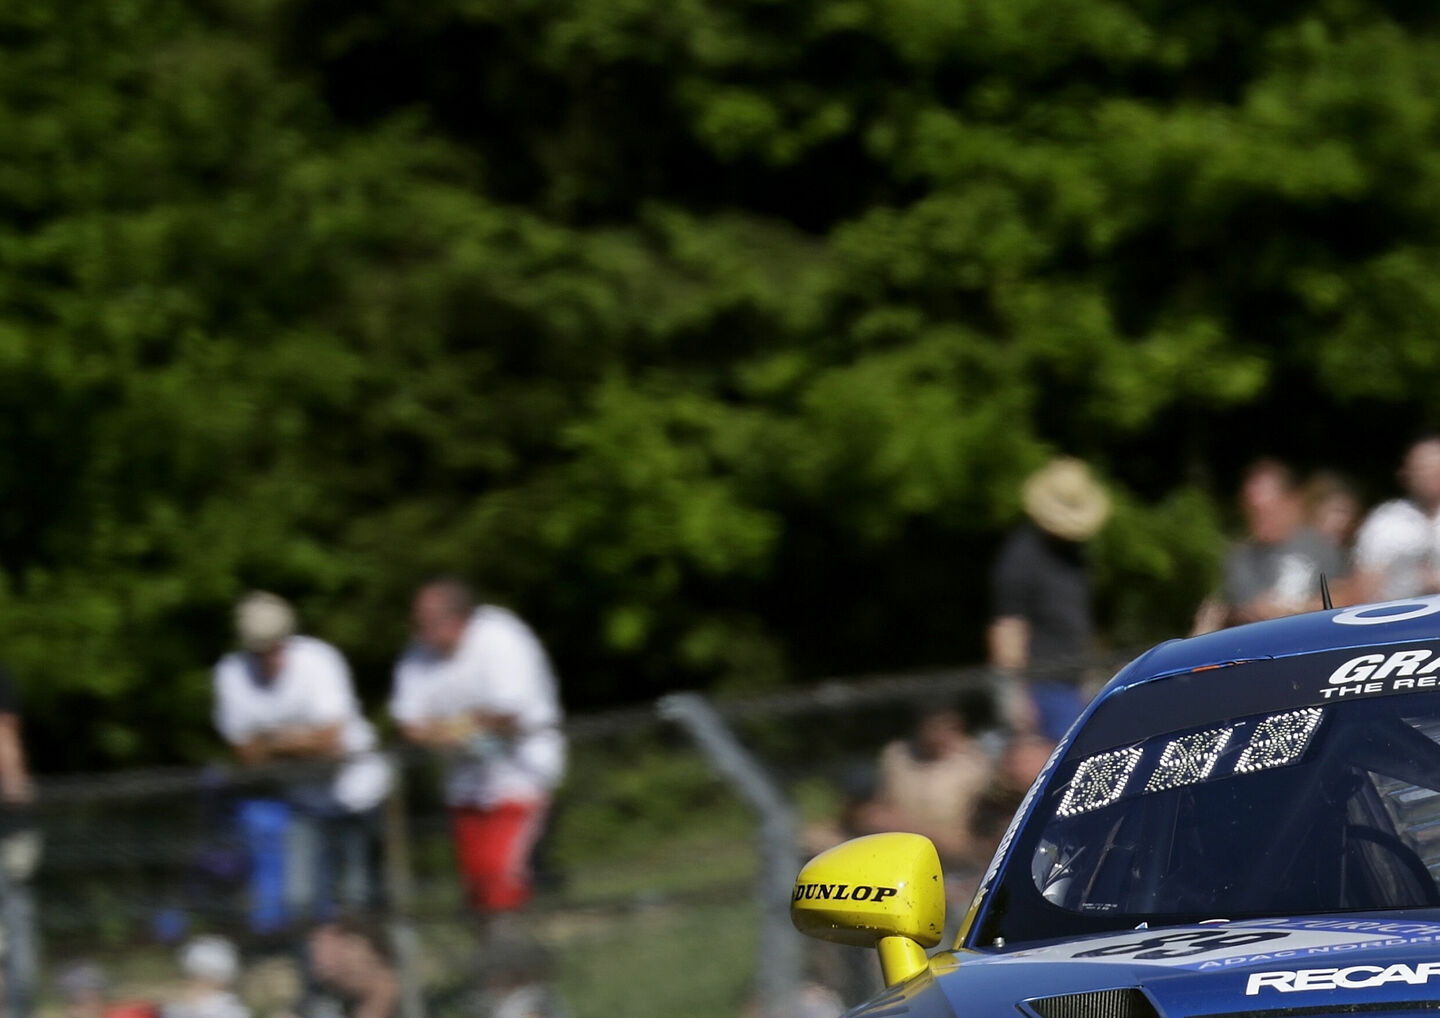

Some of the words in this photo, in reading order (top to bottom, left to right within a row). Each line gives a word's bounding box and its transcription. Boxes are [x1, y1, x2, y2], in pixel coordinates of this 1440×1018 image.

[1320, 681, 1384, 698] THE
[795, 883, 898, 902] DUNLOP
[1198, 950, 1296, 970] ADAC
